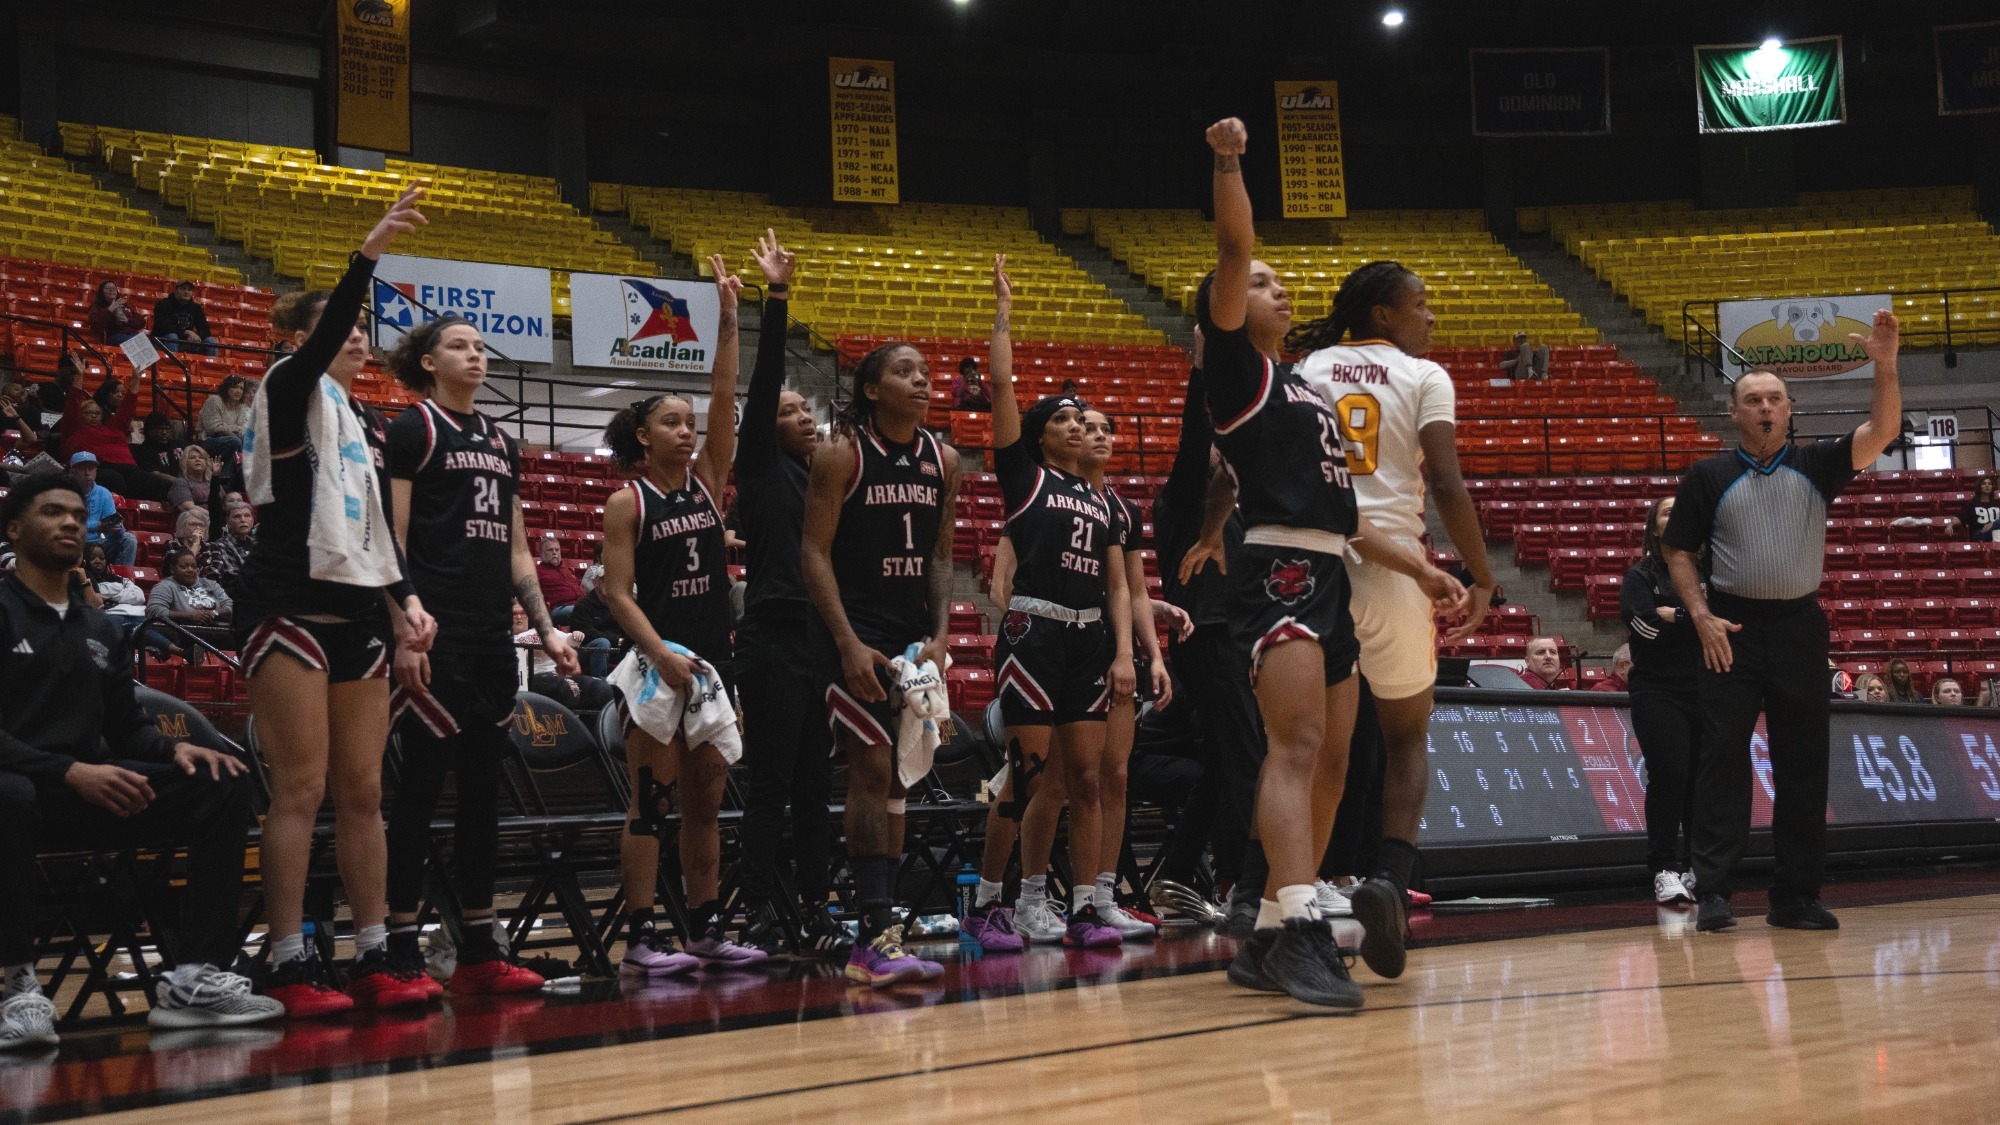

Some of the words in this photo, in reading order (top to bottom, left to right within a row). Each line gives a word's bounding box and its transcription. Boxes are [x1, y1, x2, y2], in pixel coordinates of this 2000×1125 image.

[342, 34, 406, 54] POST-SEASON
[341, 47, 407, 64] APPEARANCES
[344, 72, 368, 84] 2018
[379, 78, 394, 88] CIT
[834, 72, 888, 89] ULM
[1524, 72, 1556, 88] OLD
[1721, 76, 1820, 98] MARSHALL
[343, 83, 368, 96] 2019
[379, 89, 394, 100] CIT
[835, 102, 892, 113] POST-SEASON
[1280, 92, 1332, 109] ULM
[1500, 96, 1582, 112] DOMINION
[834, 112, 894, 123] APPEARANCES
[837, 124, 859, 133] 1970
[869, 126, 890, 134] NAIA
[1282, 123, 1336, 131] POST-SEASON
[837, 137, 859, 146] 1971
[870, 138, 890, 147] NAIA
[1282, 133, 1338, 141] APPEARANCES
[838, 149, 859, 158] 1979
[870, 151, 884, 159] NIT
[1315, 144, 1338, 152] NCAA
[838, 162, 860, 170] 1982
[871, 163, 894, 172] NCAA
[1285, 156, 1306, 164] 1991
[1316, 156, 1339, 164] NCAA
[838, 174, 860, 183] 1986
[871, 176, 894, 185] NCAA
[1286, 168, 1307, 176] 1992
[1317, 168, 1340, 176] NCAA
[838, 187, 861, 196] 1988
[872, 188, 886, 196] NIT
[1286, 180, 1308, 188] 1993
[1287, 192, 1308, 200] 1996
[1287, 204, 1309, 212] 2015
[1319, 204, 1333, 212] CBI
[422, 284, 496, 310] FIRST
[422, 307, 542, 337] HRIZON
[610, 338, 705, 362] Acadian
[1728, 342, 1869, 366] CATAHOULA
[610, 357, 664, 368] Ambulance
[668, 360, 704, 370] Service
[1332, 364, 1390, 384] BROWN
[1336, 393, 1380, 475] 9
[1930, 418, 1956, 437] 118
[474, 476, 500, 515] 24
[466, 519, 508, 542] STATE
[903, 512, 914, 549] 1
[1071, 516, 1093, 552] 21
[686, 537, 700, 572] 3
[883, 557, 923, 576] STAT
[1061, 552, 1099, 576] STATE
[1464, 706, 1499, 724] Player
[1501, 707, 1525, 722] Foul
[1526, 708, 1560, 724] Points
[1577, 719, 1594, 744] 2
[1453, 731, 1474, 752] 16
[1495, 731, 1508, 752] 5
[1528, 732, 1539, 753] 1
[1548, 732, 1566, 753] 11
[1583, 756, 1611, 768] FOULS
[1853, 734, 1937, 802] 45.8
[1437, 769, 1449, 790] 0
[1476, 769, 1489, 790] 6
[1504, 768, 1525, 790] 21
[1542, 768, 1554, 788] 1
[1567, 768, 1579, 788] 5
[1606, 781, 1618, 806] 4
[1450, 805, 1465, 828] 2
[1489, 804, 1503, 826] 8
